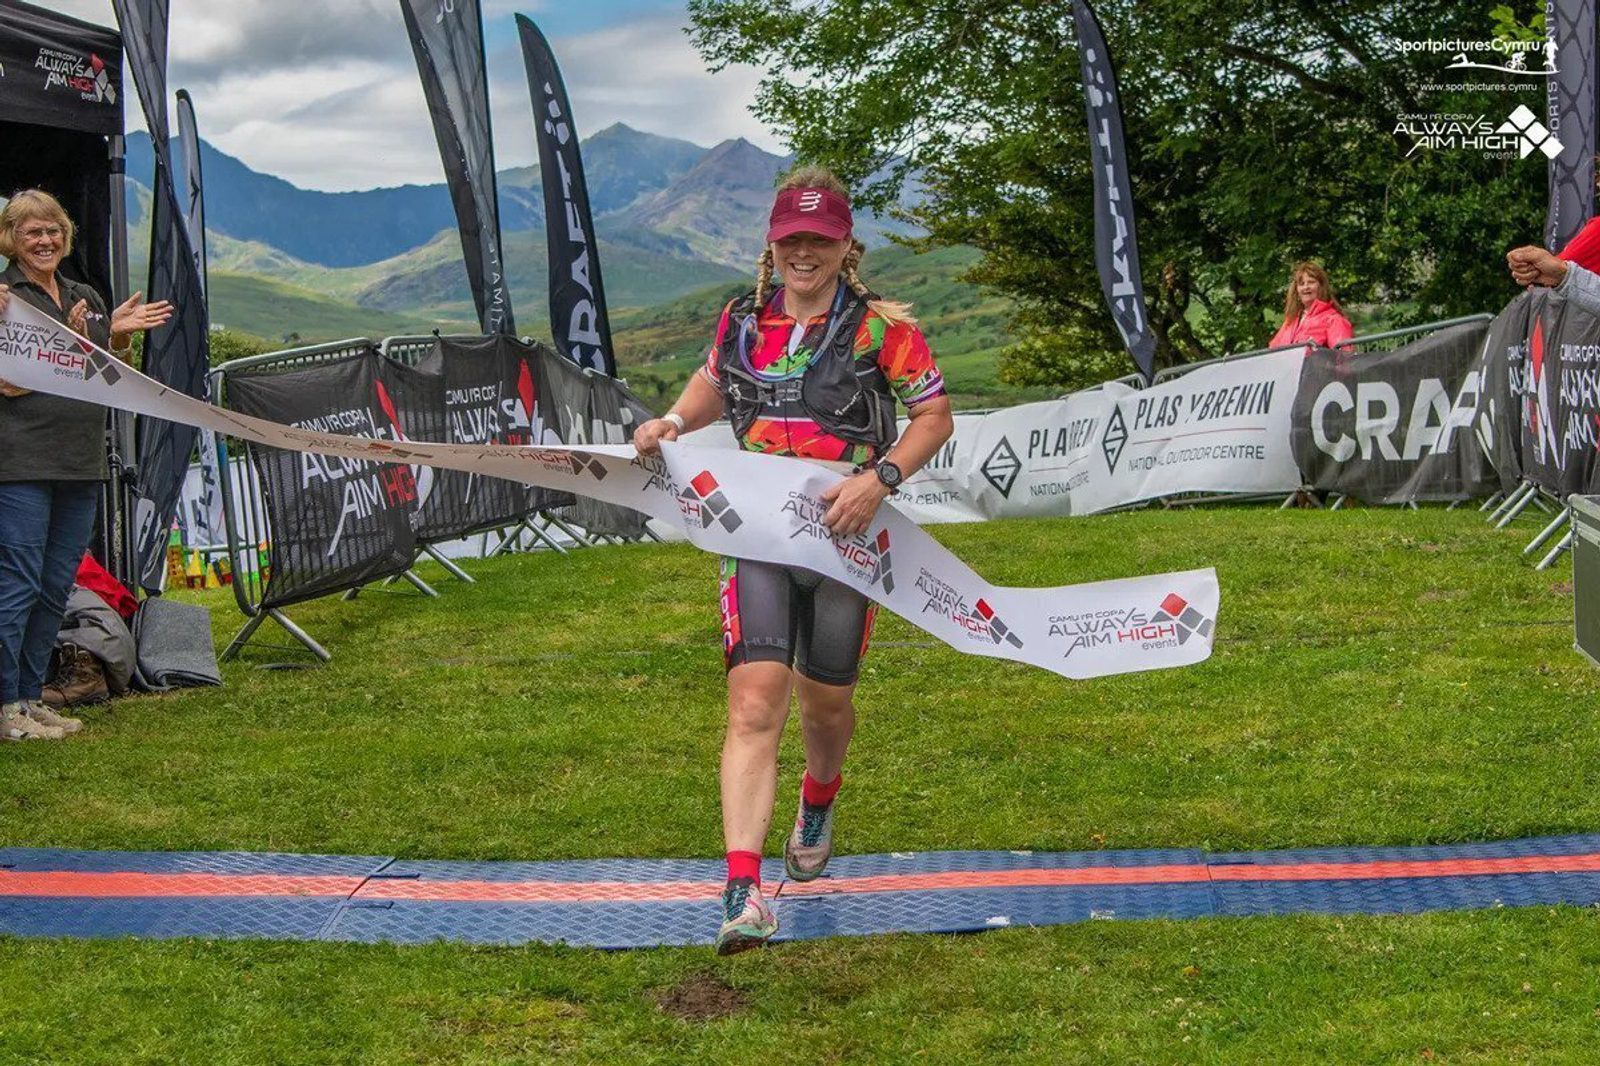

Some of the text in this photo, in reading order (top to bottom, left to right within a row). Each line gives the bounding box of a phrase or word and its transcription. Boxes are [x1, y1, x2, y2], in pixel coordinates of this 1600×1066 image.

[35, 55, 85, 77] ALWAYS
[44, 71, 68, 90] AIM
[1548, 81, 1561, 142] PORTS
[25, 324, 51, 335] COPA
[0, 342, 85, 369] AIM HIGH
[53, 367, 84, 380] events
[340, 409, 369, 428] COPA
[1134, 394, 1183, 430] PLAS
[1028, 427, 1067, 459] PLA
[1212, 445, 1265, 460] CENTRE
[1030, 482, 1071, 497] NATIONA
[327, 474, 387, 556] AIM
[915, 576, 969, 617] ALWAYS
[922, 598, 990, 635] AIM HIGH
[1048, 615, 1079, 624] CAMU
[1095, 609, 1126, 618] COPA
[1048, 607, 1148, 636] ALWAYS
[1064, 623, 1175, 658] AIM HIGH
[1141, 638, 1178, 650] events
